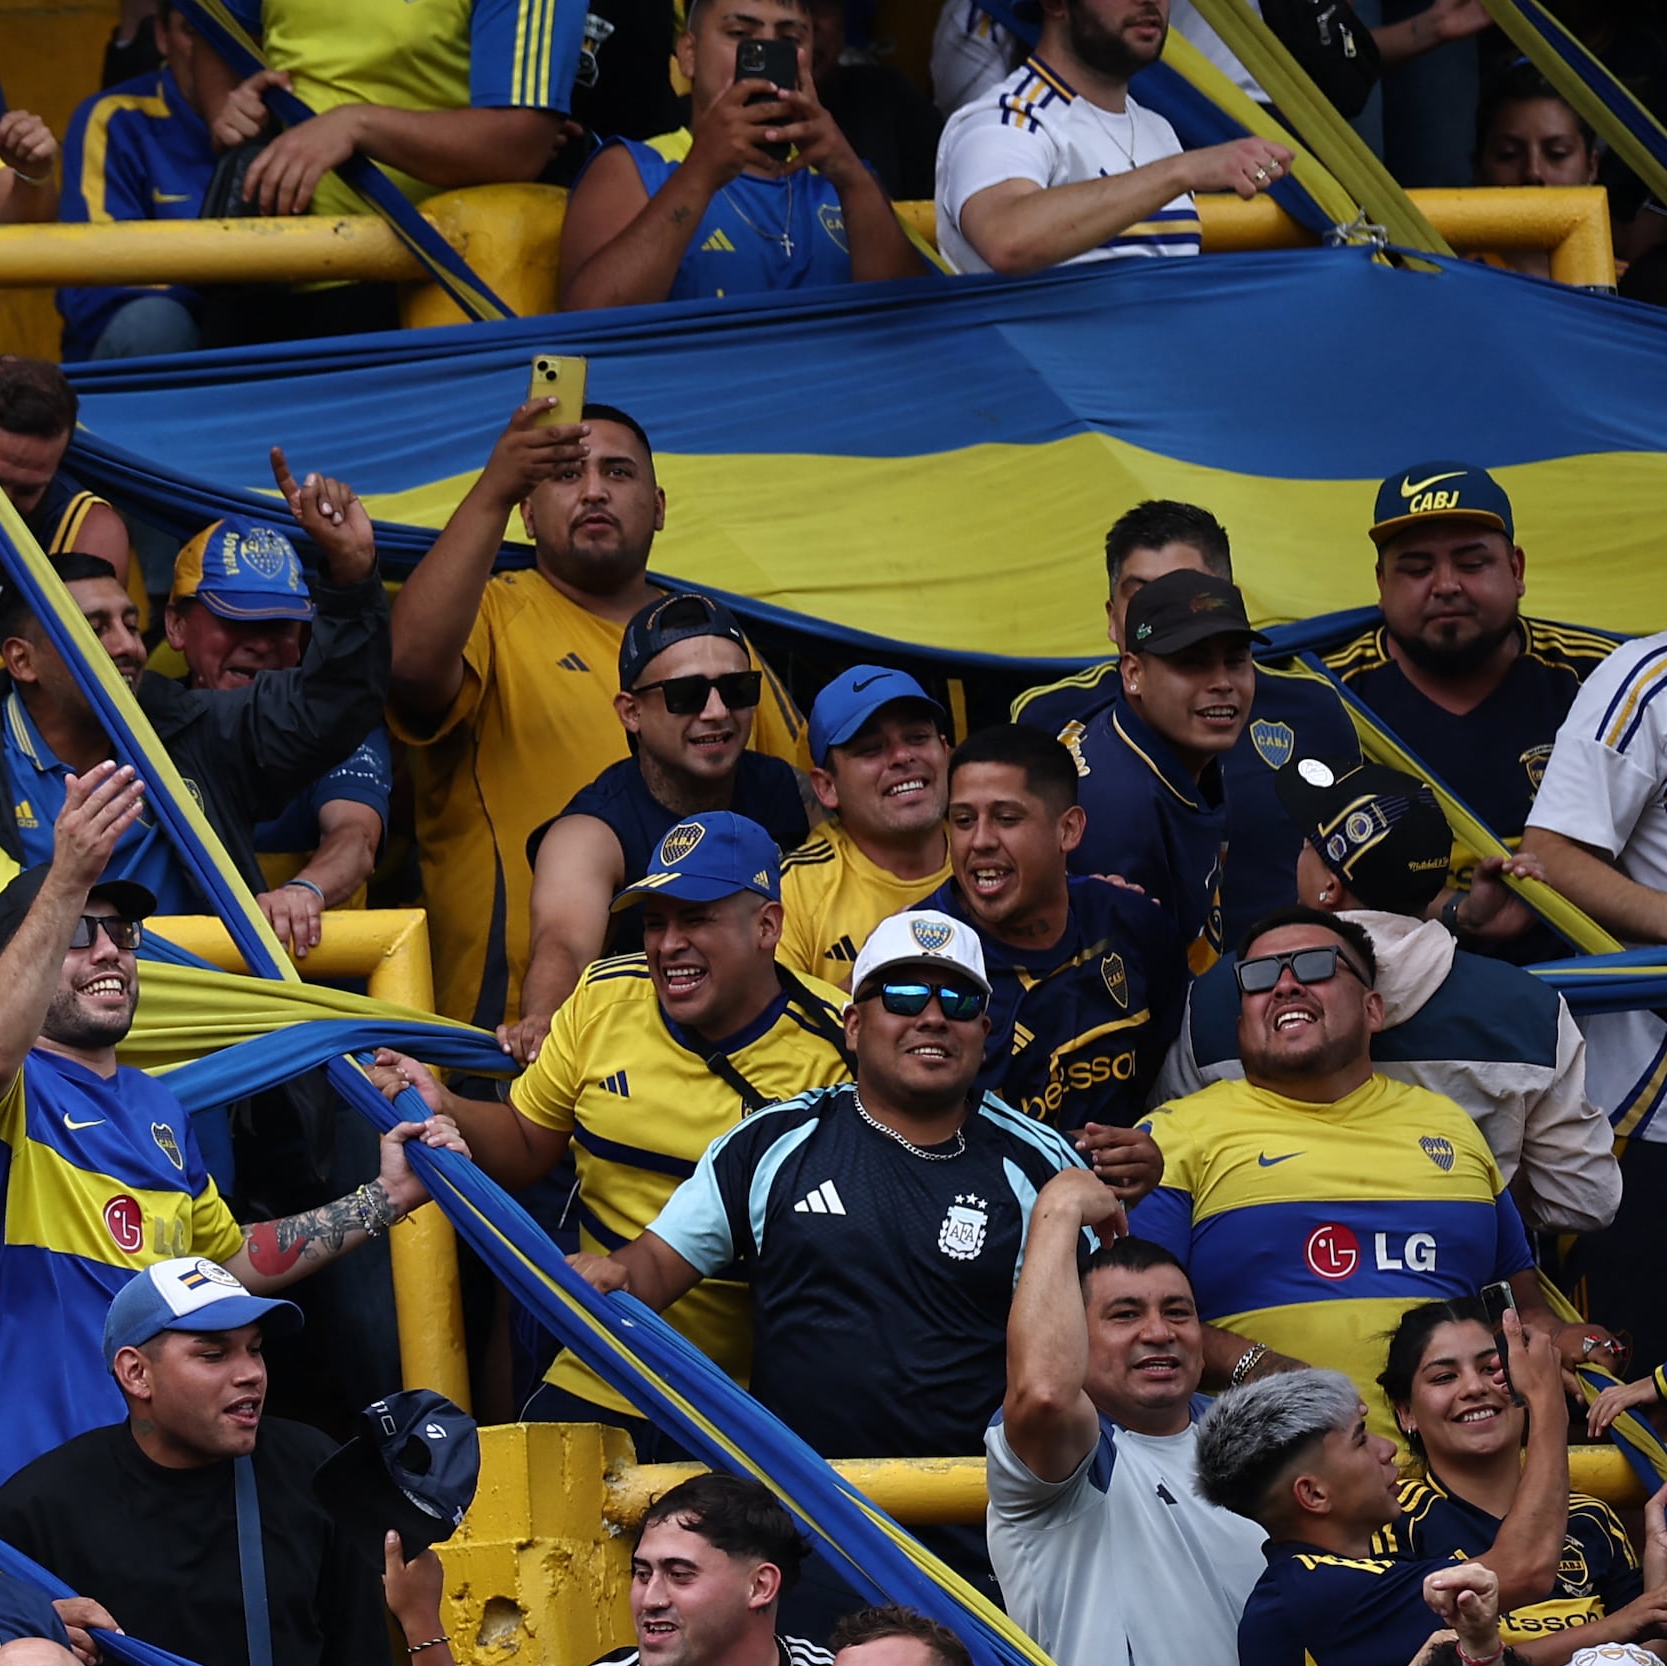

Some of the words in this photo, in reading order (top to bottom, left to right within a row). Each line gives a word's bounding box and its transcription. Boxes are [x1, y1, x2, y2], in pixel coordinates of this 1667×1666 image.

[1409, 490, 1460, 513] CABJ
[949, 1221, 976, 1244] AFA
[1374, 1232, 1437, 1273] LG
[1496, 1606, 1602, 1633] tsson
